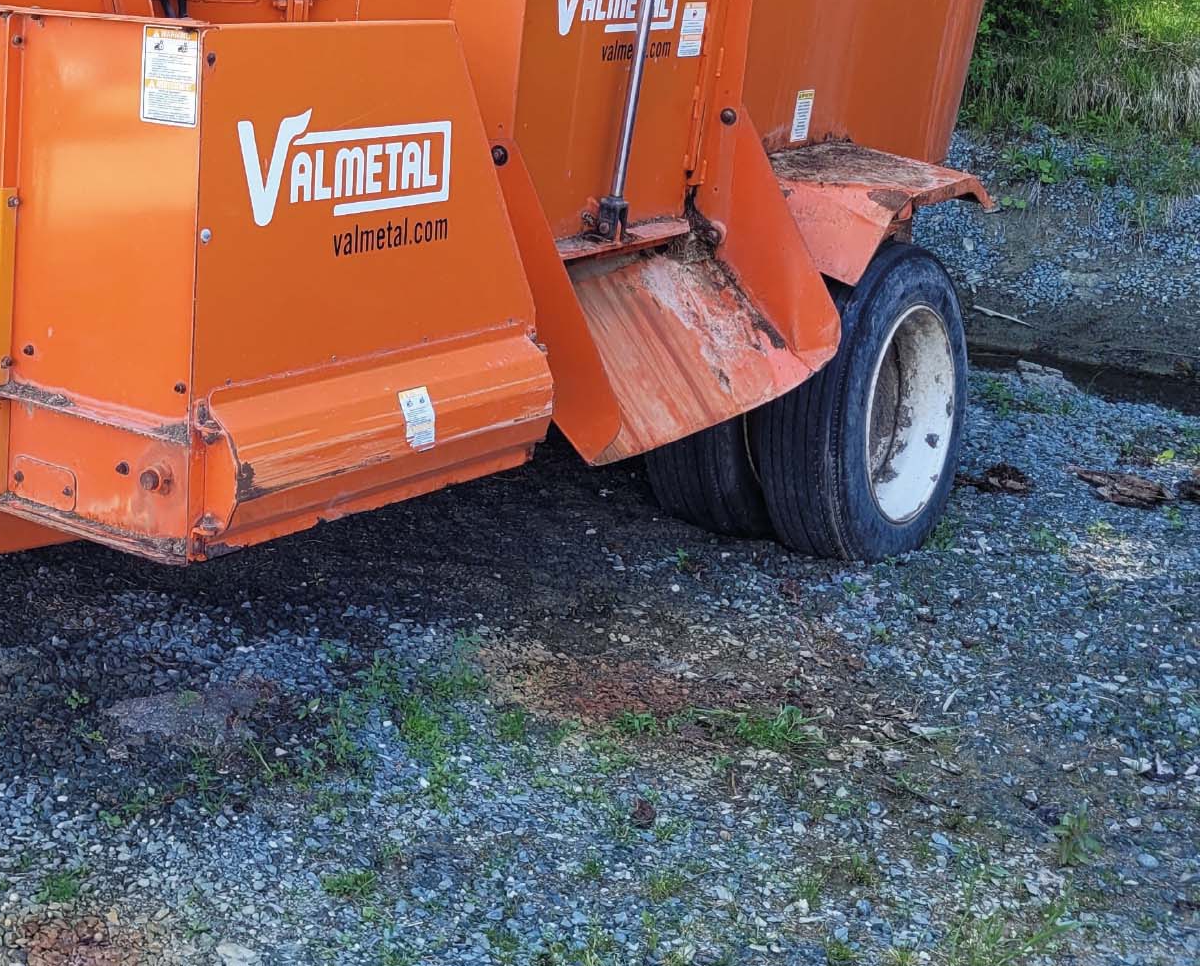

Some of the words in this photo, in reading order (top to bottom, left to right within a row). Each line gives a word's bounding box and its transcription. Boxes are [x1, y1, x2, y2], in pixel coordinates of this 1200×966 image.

[601, 40, 671, 62] valme.com
[238, 108, 438, 227] VALMETAL
[333, 215, 449, 258] valmetal.com
